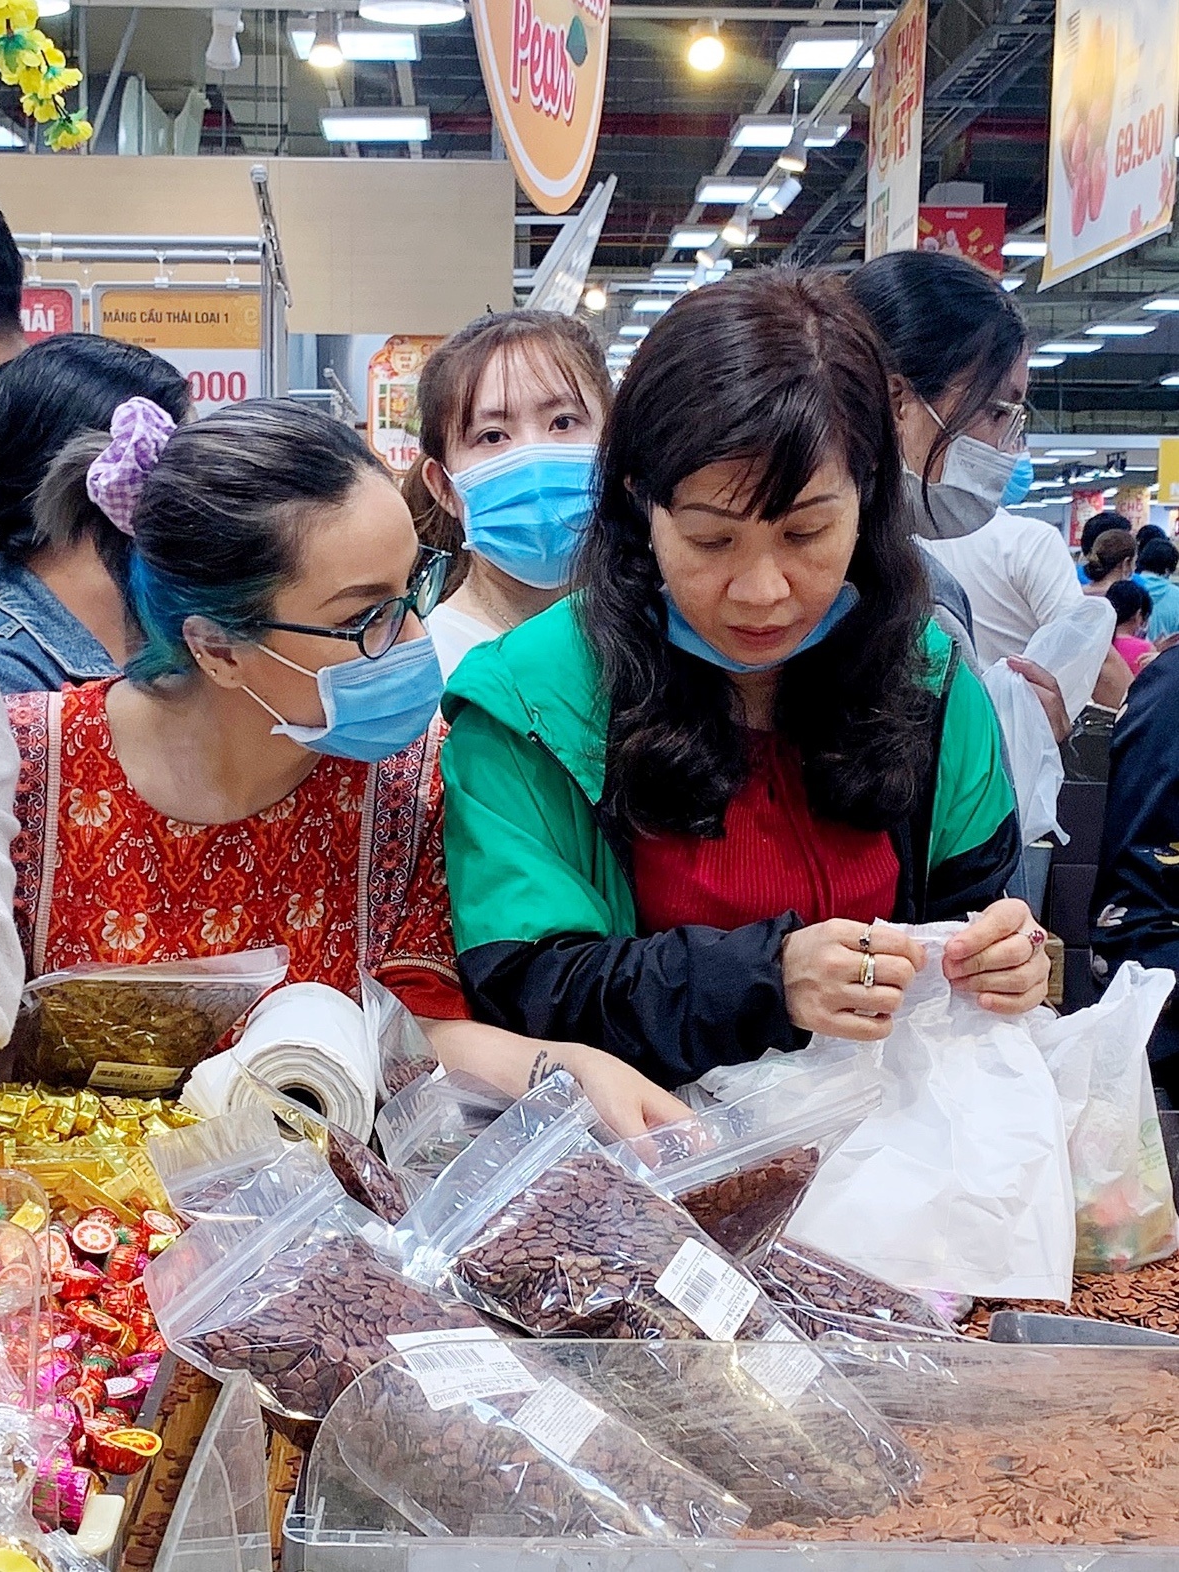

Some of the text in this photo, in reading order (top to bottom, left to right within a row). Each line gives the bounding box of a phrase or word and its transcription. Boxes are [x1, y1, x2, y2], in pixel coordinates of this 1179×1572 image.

[511, 0, 575, 122] Pear
[1115, 102, 1165, 178] 69.900
[223, 313, 230, 323] 1
